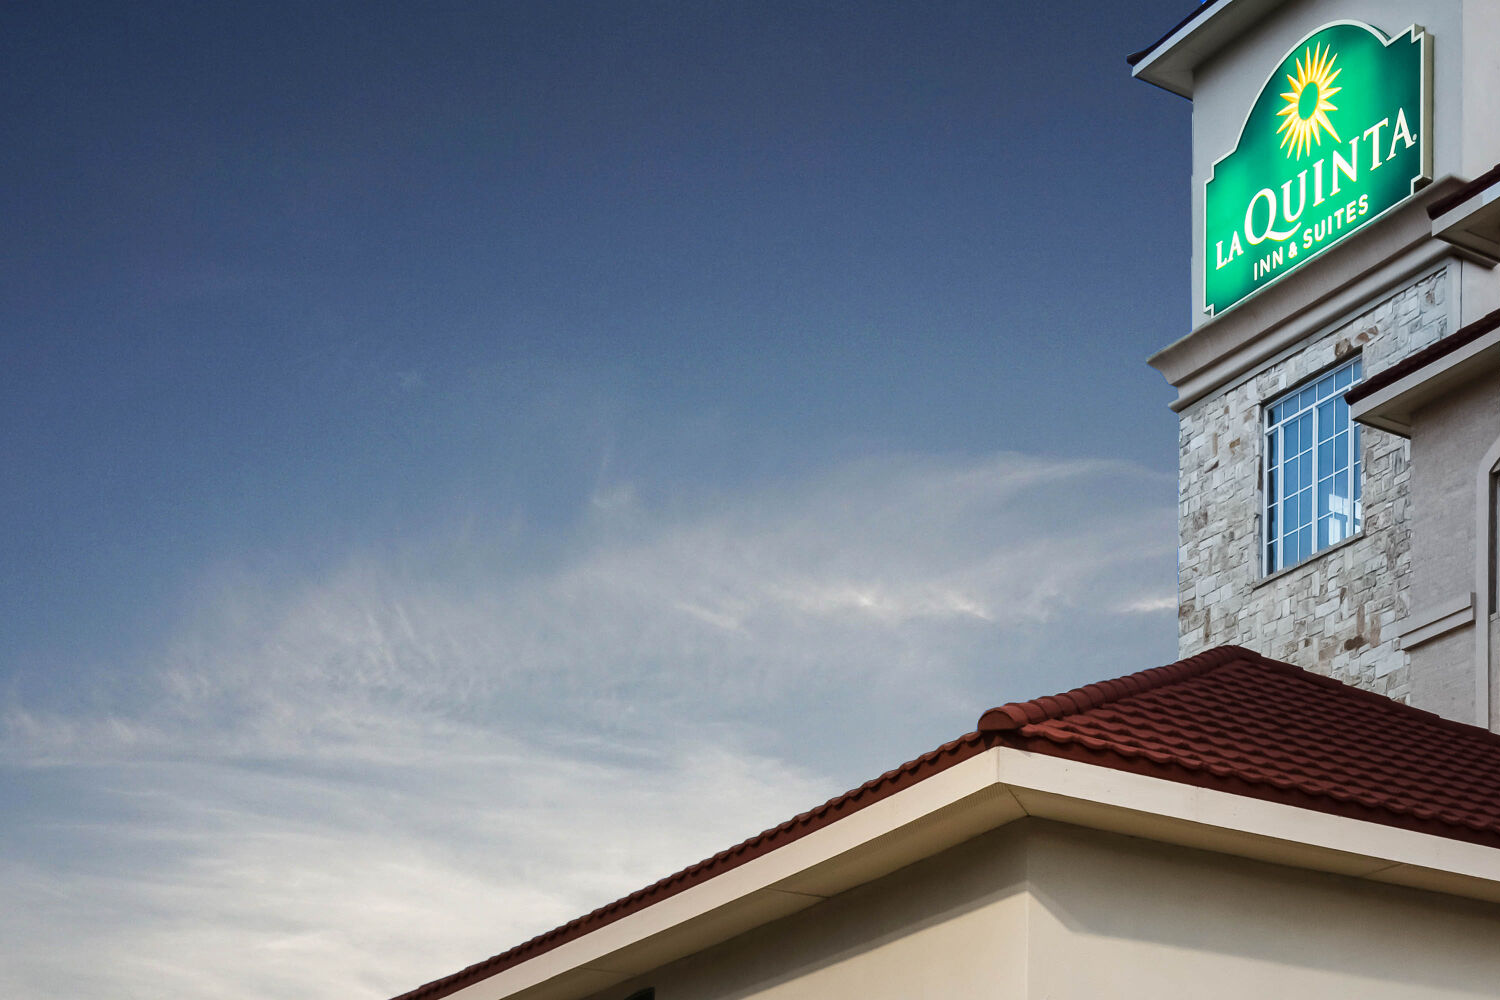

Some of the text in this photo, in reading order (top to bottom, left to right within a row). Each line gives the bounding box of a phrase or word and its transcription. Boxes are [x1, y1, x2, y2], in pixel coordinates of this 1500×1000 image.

[1216, 107, 1416, 270] LA QUINTA
[1254, 194, 1369, 280] INN & SUITES
